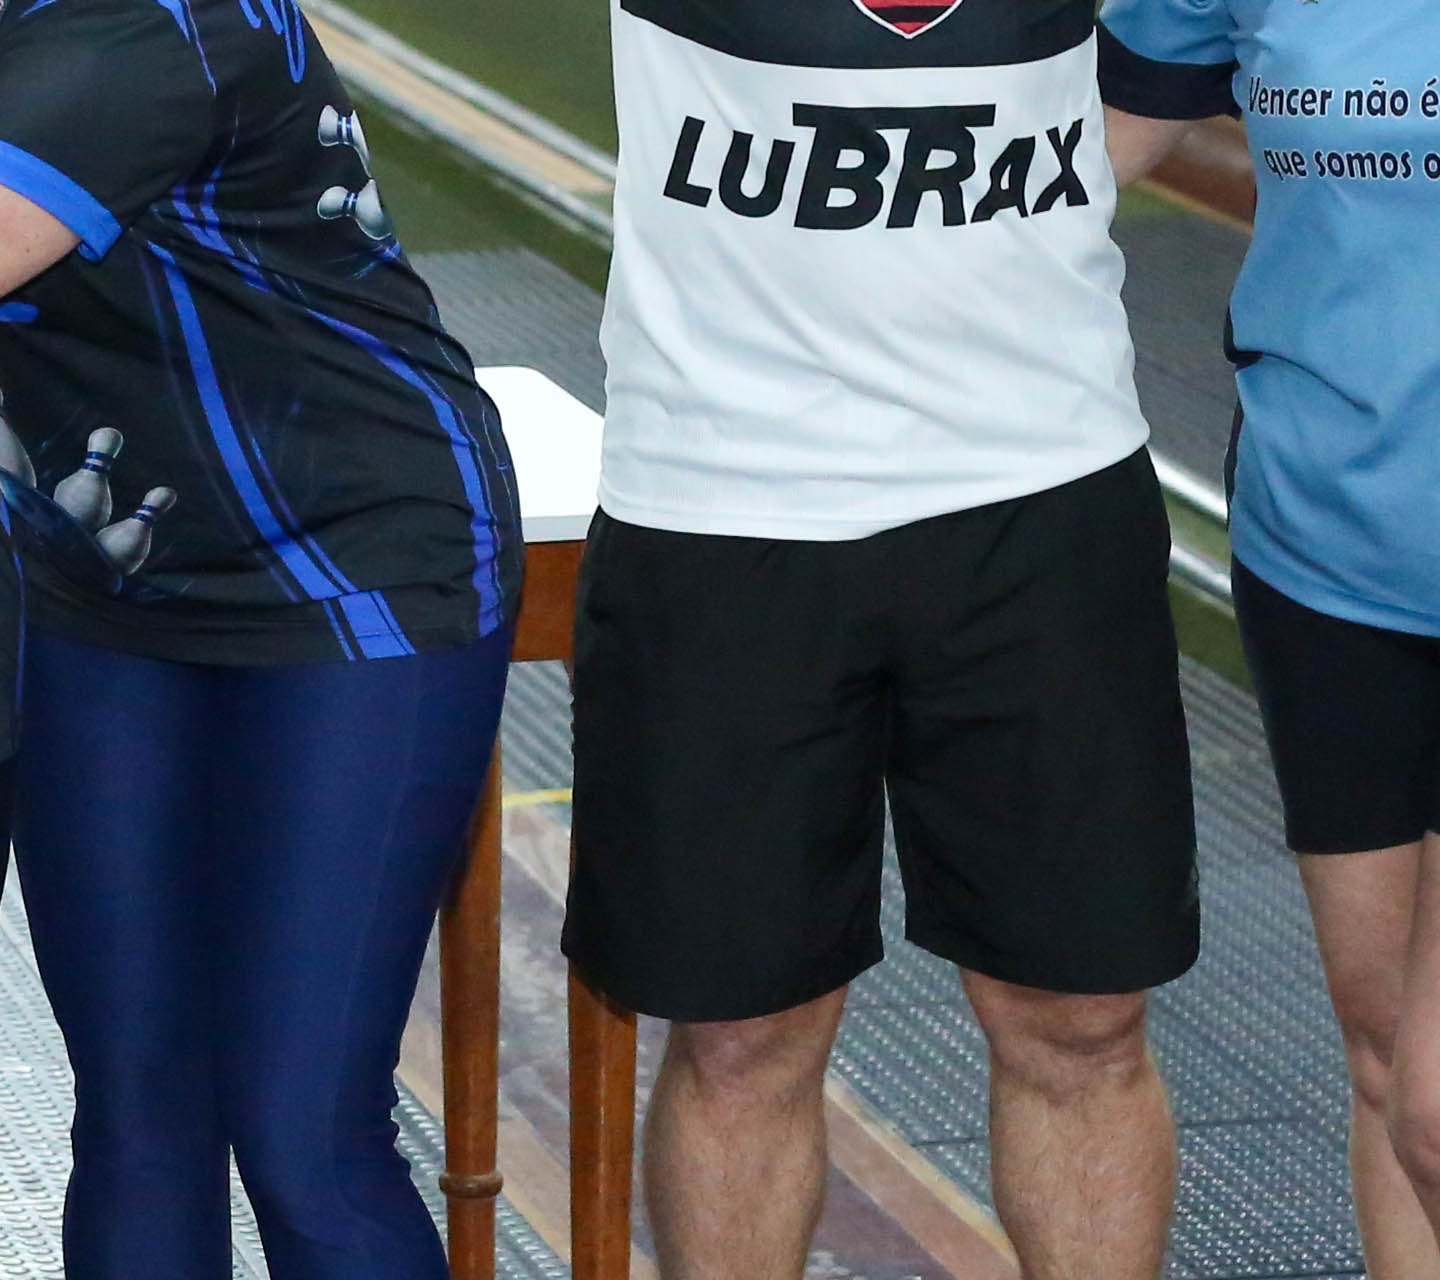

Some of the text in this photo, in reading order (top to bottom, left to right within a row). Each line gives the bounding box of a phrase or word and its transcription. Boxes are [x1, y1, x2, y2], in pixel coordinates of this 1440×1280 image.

[1248, 77, 1333, 118] Vencer
[1344, 79, 1409, 119] não
[1420, 77, 1440, 118] é
[663, 102, 1089, 230] LUBRAX
[1264, 147, 1308, 181] que
[1315, 148, 1412, 180] somos
